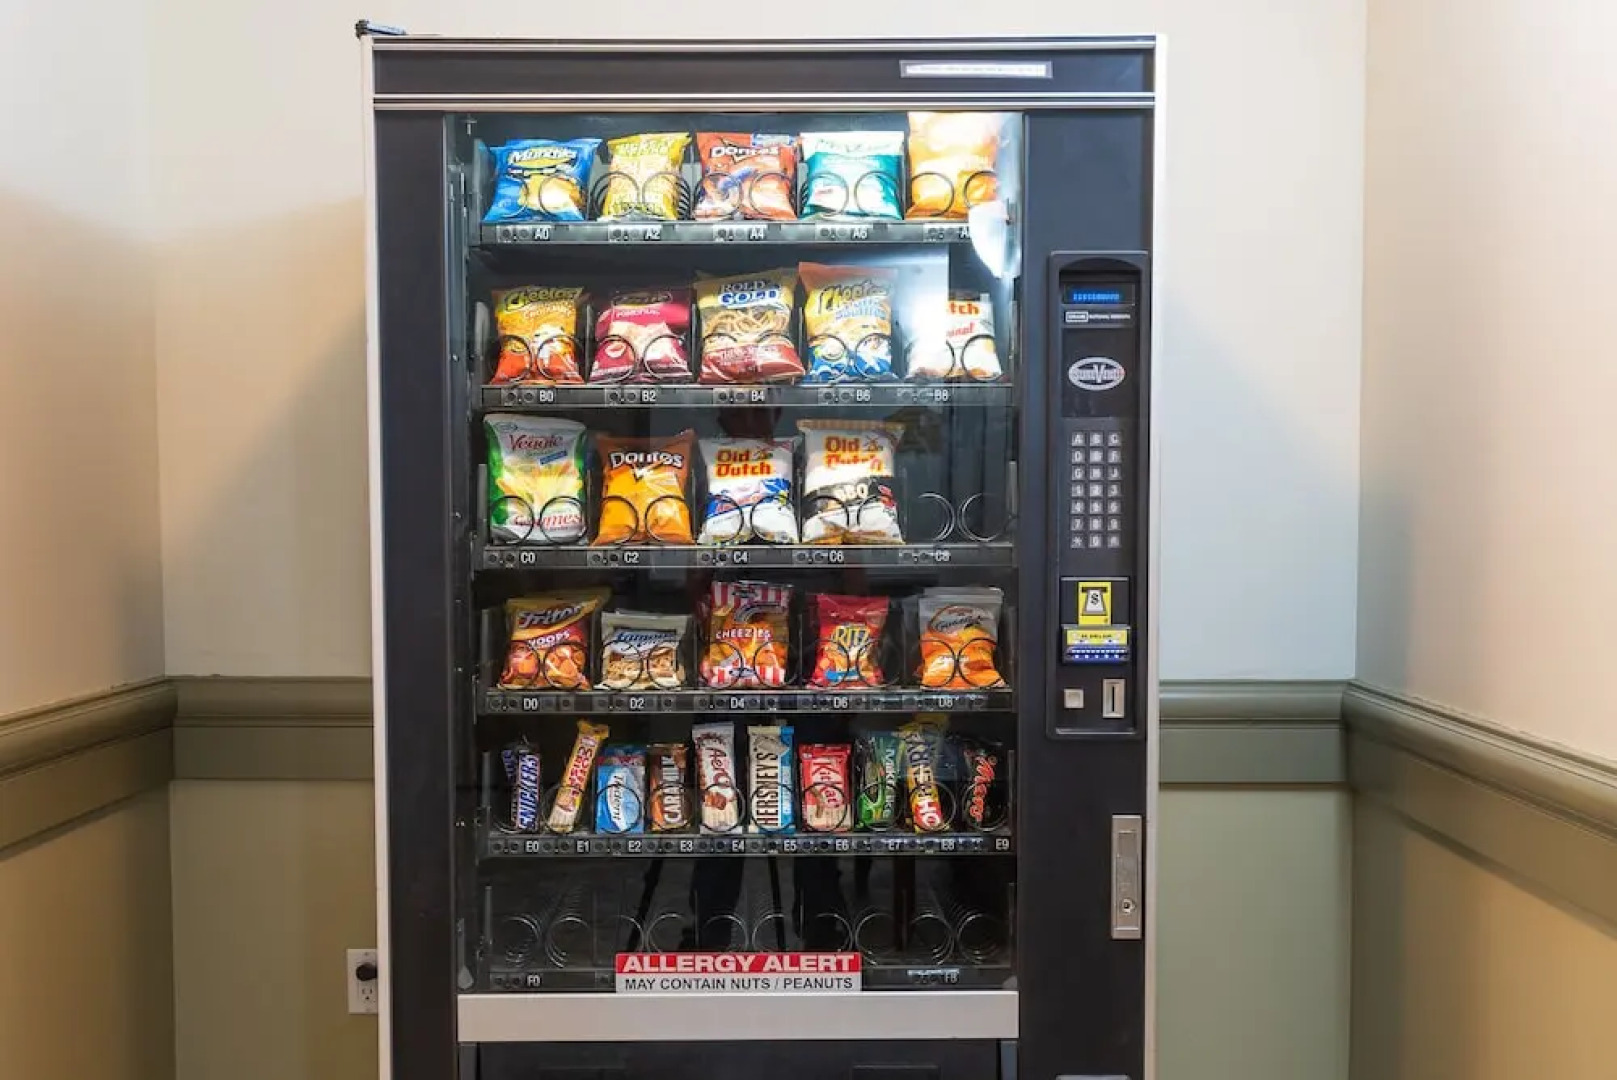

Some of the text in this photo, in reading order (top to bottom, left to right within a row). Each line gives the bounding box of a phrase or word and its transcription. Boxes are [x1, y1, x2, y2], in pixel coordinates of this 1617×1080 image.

[534, 228, 548, 240] A0
[645, 228, 660, 240] A2
[749, 228, 765, 240] A4
[721, 280, 767, 293] ROLD
[504, 287, 582, 311] Cheetos
[718, 289, 781, 306] GOLD
[949, 302, 979, 315] tch
[539, 389, 554, 402] B0
[641, 389, 657, 402] B2
[751, 389, 765, 402] B4
[856, 389, 871, 402] B6
[933, 389, 949, 402] B8
[826, 436, 860, 453] Old
[609, 451, 684, 469] Doritos
[717, 449, 750, 462] Old
[717, 462, 771, 477] Dutch
[520, 552, 536, 563] C0
[623, 551, 640, 564] C2
[733, 551, 749, 564] C4
[829, 550, 844, 562] C6
[518, 604, 584, 629] Fritos
[528, 630, 571, 649] HOOPS
[716, 628, 772, 640] CHEEZIES
[833, 625, 871, 648] RITZ
[523, 697, 538, 710] D0
[630, 697, 645, 709] D2
[730, 697, 745, 709] D4
[833, 696, 848, 708] D6
[939, 697, 953, 708] D8
[704, 746, 732, 789] Aero
[518, 755, 538, 829] SNICKERS
[661, 755, 682, 824] CARAMILK
[756, 752, 779, 827] HERSHEY'S
[611, 774, 625, 821] Trident
[917, 799, 942, 828] OH
[525, 841, 540, 853] E0
[576, 841, 590, 853] E1
[628, 840, 642, 853] E2
[680, 840, 693, 853] E3
[732, 840, 746, 852] E4
[783, 840, 798, 852] E5
[835, 839, 850, 851] E6
[889, 840, 902, 851] E7
[941, 838, 955, 850] E8
[995, 838, 1010, 850] E9
[623, 955, 855, 973] ALLERGY ALERT
[526, 974, 541, 986] F0
[625, 977, 853, 991] MAY CONTAIN NUTS / PEANUTS
